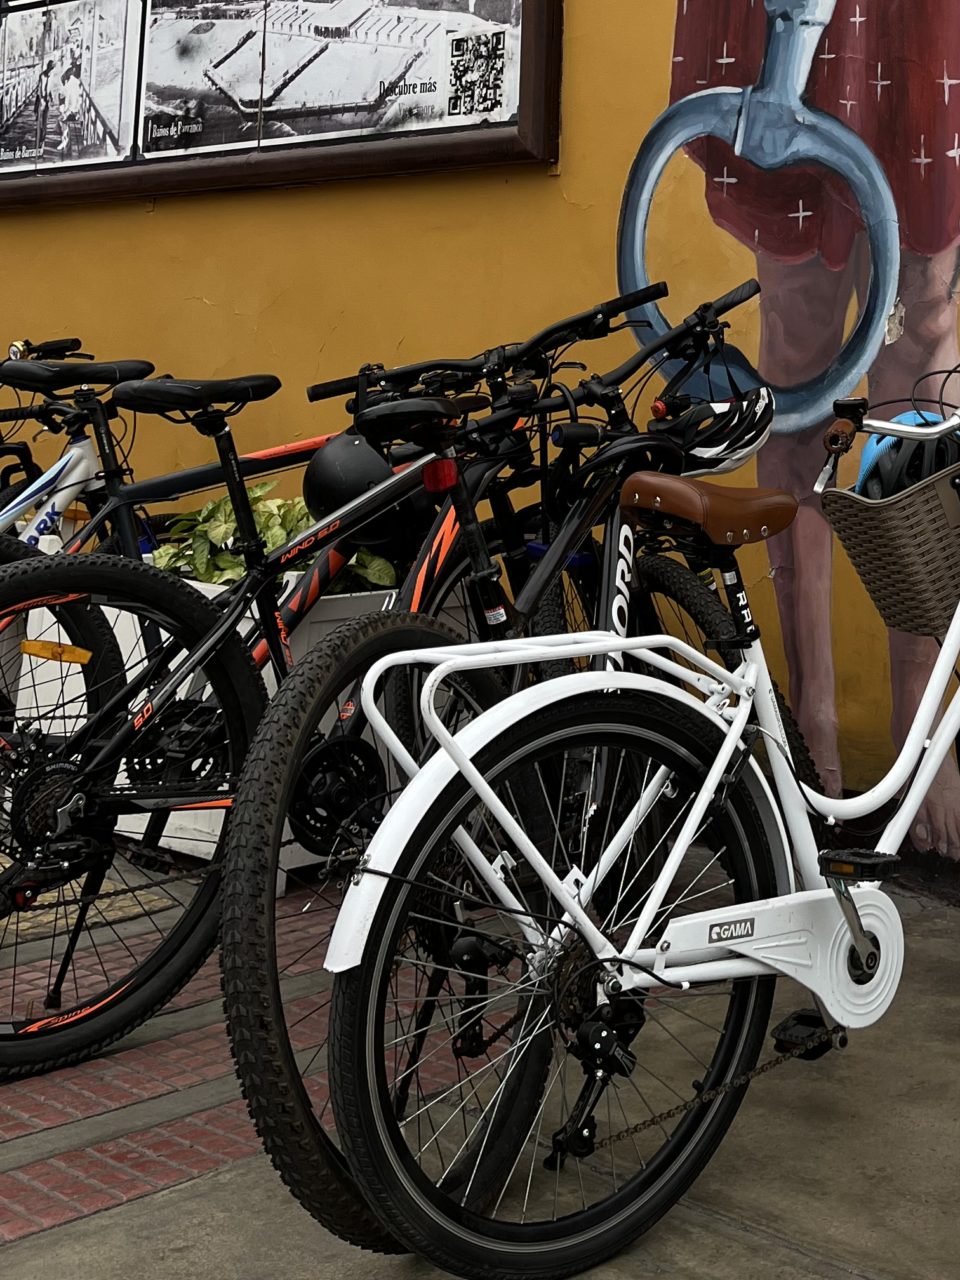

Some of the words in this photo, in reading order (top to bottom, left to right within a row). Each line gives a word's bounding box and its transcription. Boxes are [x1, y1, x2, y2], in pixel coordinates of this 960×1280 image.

[420, 77, 437, 94] más
[152, 124, 169, 138] Baños
[15, 146, 21, 159] de
[281, 537, 315, 564] WIND
[133, 703, 154, 731] 5.0
[720, 921, 752, 939] GAMA
